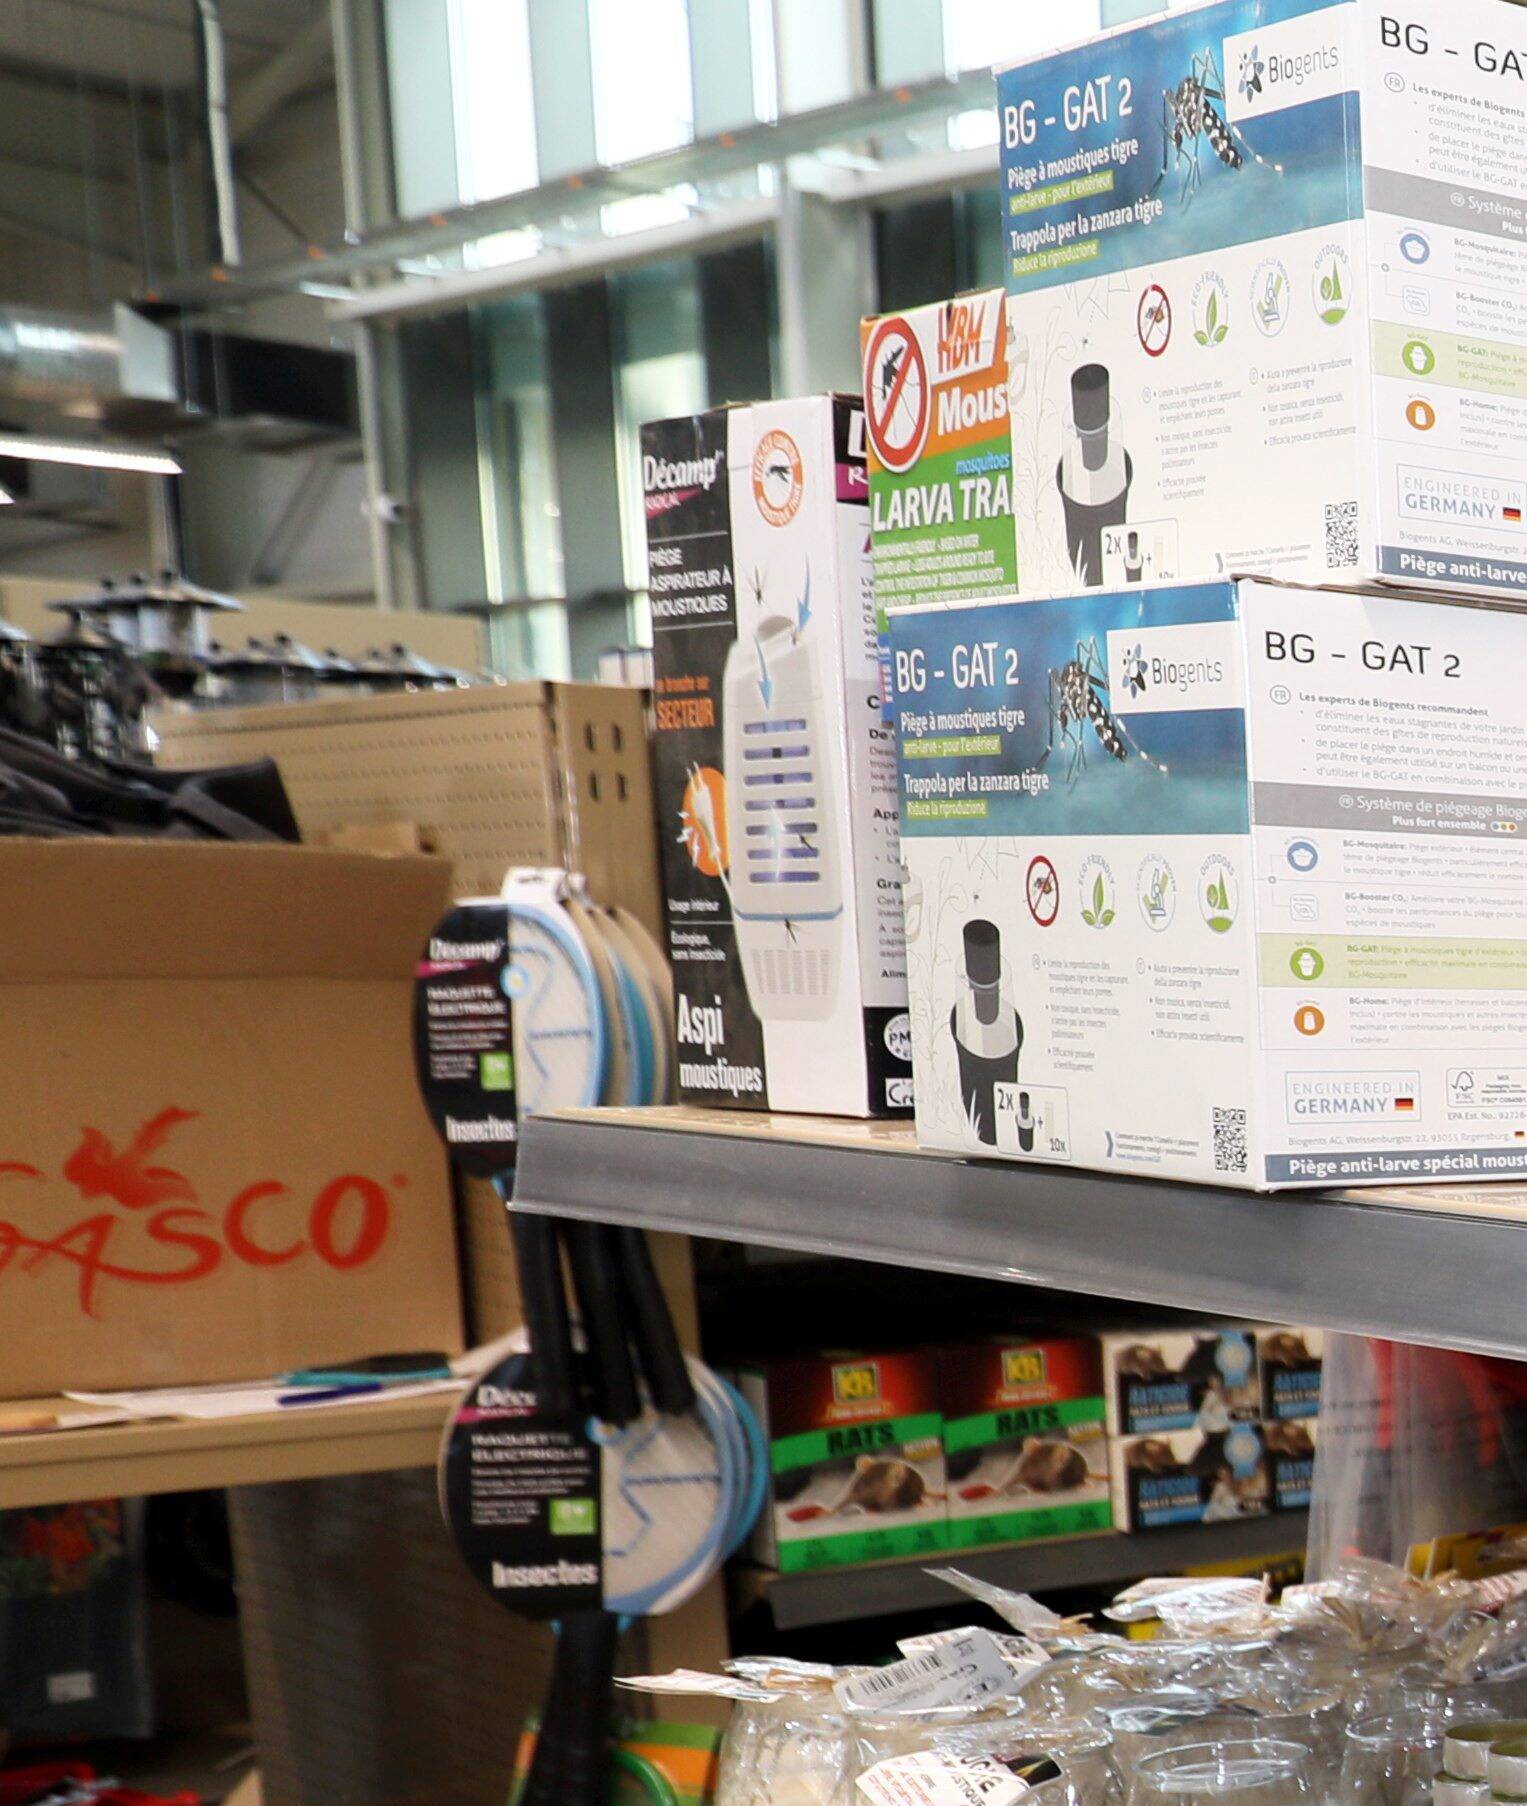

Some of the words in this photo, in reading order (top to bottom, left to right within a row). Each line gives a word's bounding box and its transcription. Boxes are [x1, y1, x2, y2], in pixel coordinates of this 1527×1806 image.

[1380, 16, 1431, 56] BG
[1269, 43, 1340, 85] Biogents
[1005, 100, 1037, 149] BG
[1064, 77, 1111, 132] GAT
[1118, 79, 1133, 116] 2
[1009, 161, 1036, 191] Piège
[1046, 146, 1110, 181] moustiques
[1112, 137, 1138, 165] tigre
[1012, 223, 1056, 259] Trappola
[1059, 220, 1077, 249] per
[1079, 215, 1088, 234] la
[1090, 207, 1132, 237] zanzara
[1134, 197, 1163, 228] tigre
[956, 453, 1010, 475] mosquitoes
[874, 485, 952, 533] LARVA
[1405, 492, 1497, 521] GERMANY
[651, 546, 682, 567] PIÈGE
[1400, 553, 1447, 577] Piège
[1450, 559, 1527, 585] anti-larve
[651, 569, 720, 593] ASPIRATEUR
[722, 566, 732, 586] À
[652, 595, 728, 619] MOUSTIQUES
[896, 650, 927, 692] BG
[952, 644, 999, 690] GAT
[1004, 646, 1020, 686] 2
[1264, 631, 1317, 665] BG
[1361, 644, 1432, 676] GAT
[1442, 654, 1462, 679] 2
[1152, 656, 1223, 692] Biogents
[657, 699, 715, 729] SECTEUR
[678, 995, 724, 1048] Aspi
[680, 1059, 762, 1095] moustiques
[445, 1113, 517, 1143] Insectes
[0, 1165, 391, 1322] ASCO
[826, 1423, 894, 1456] RATS
[996, 1406, 1059, 1437] RATS
[492, 1558, 598, 1588] Insectes
